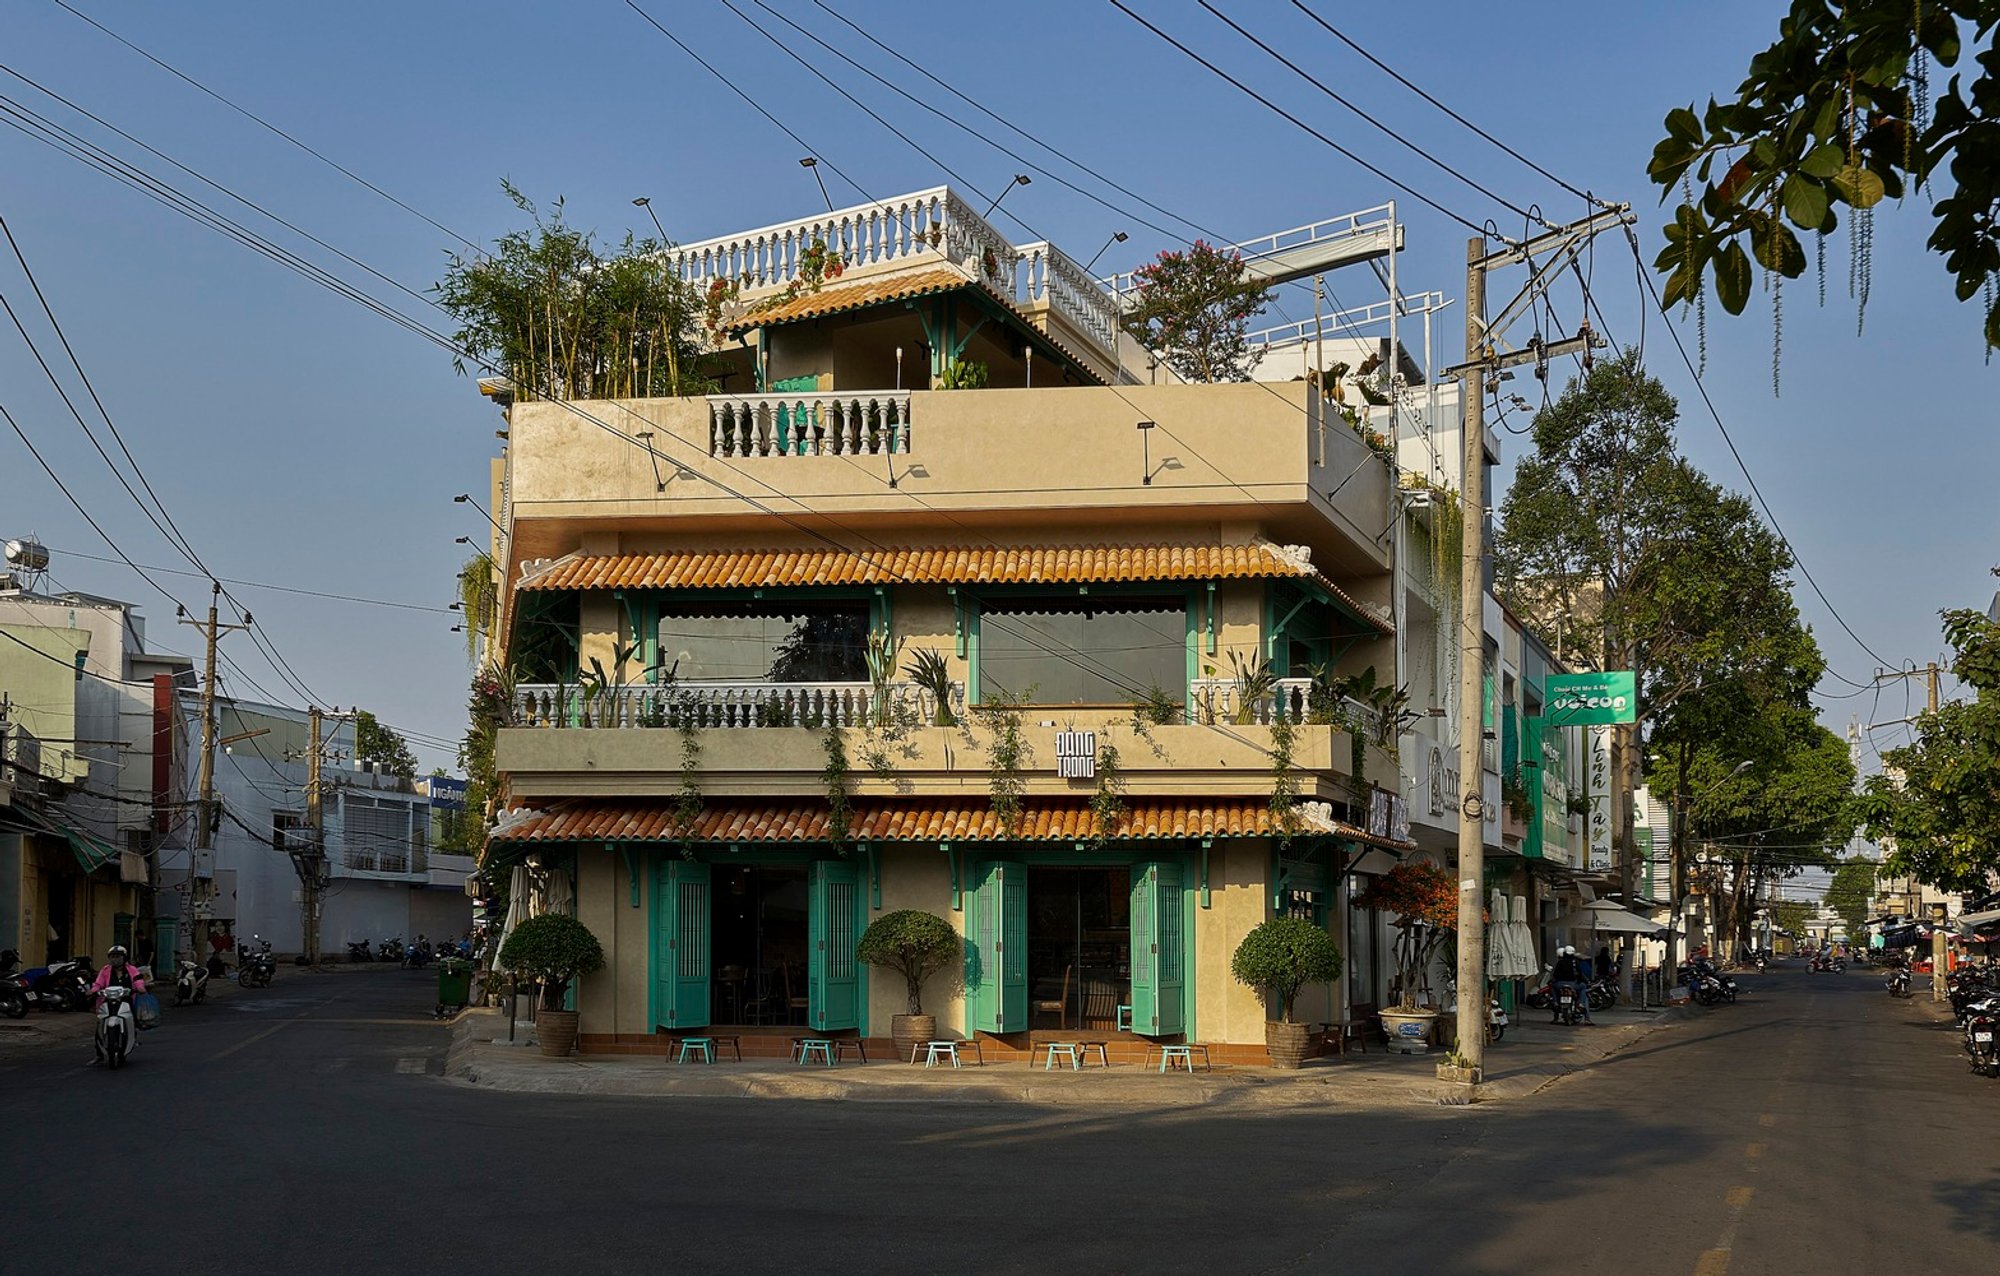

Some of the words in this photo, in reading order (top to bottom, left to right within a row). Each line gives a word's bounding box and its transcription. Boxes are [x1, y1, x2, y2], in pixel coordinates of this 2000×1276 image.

[1056, 757, 1094, 778] TRONG
[1591, 844, 1609, 856] Beauty
[1590, 859, 1595, 868] &
[1595, 859, 1611, 868] Clinic
